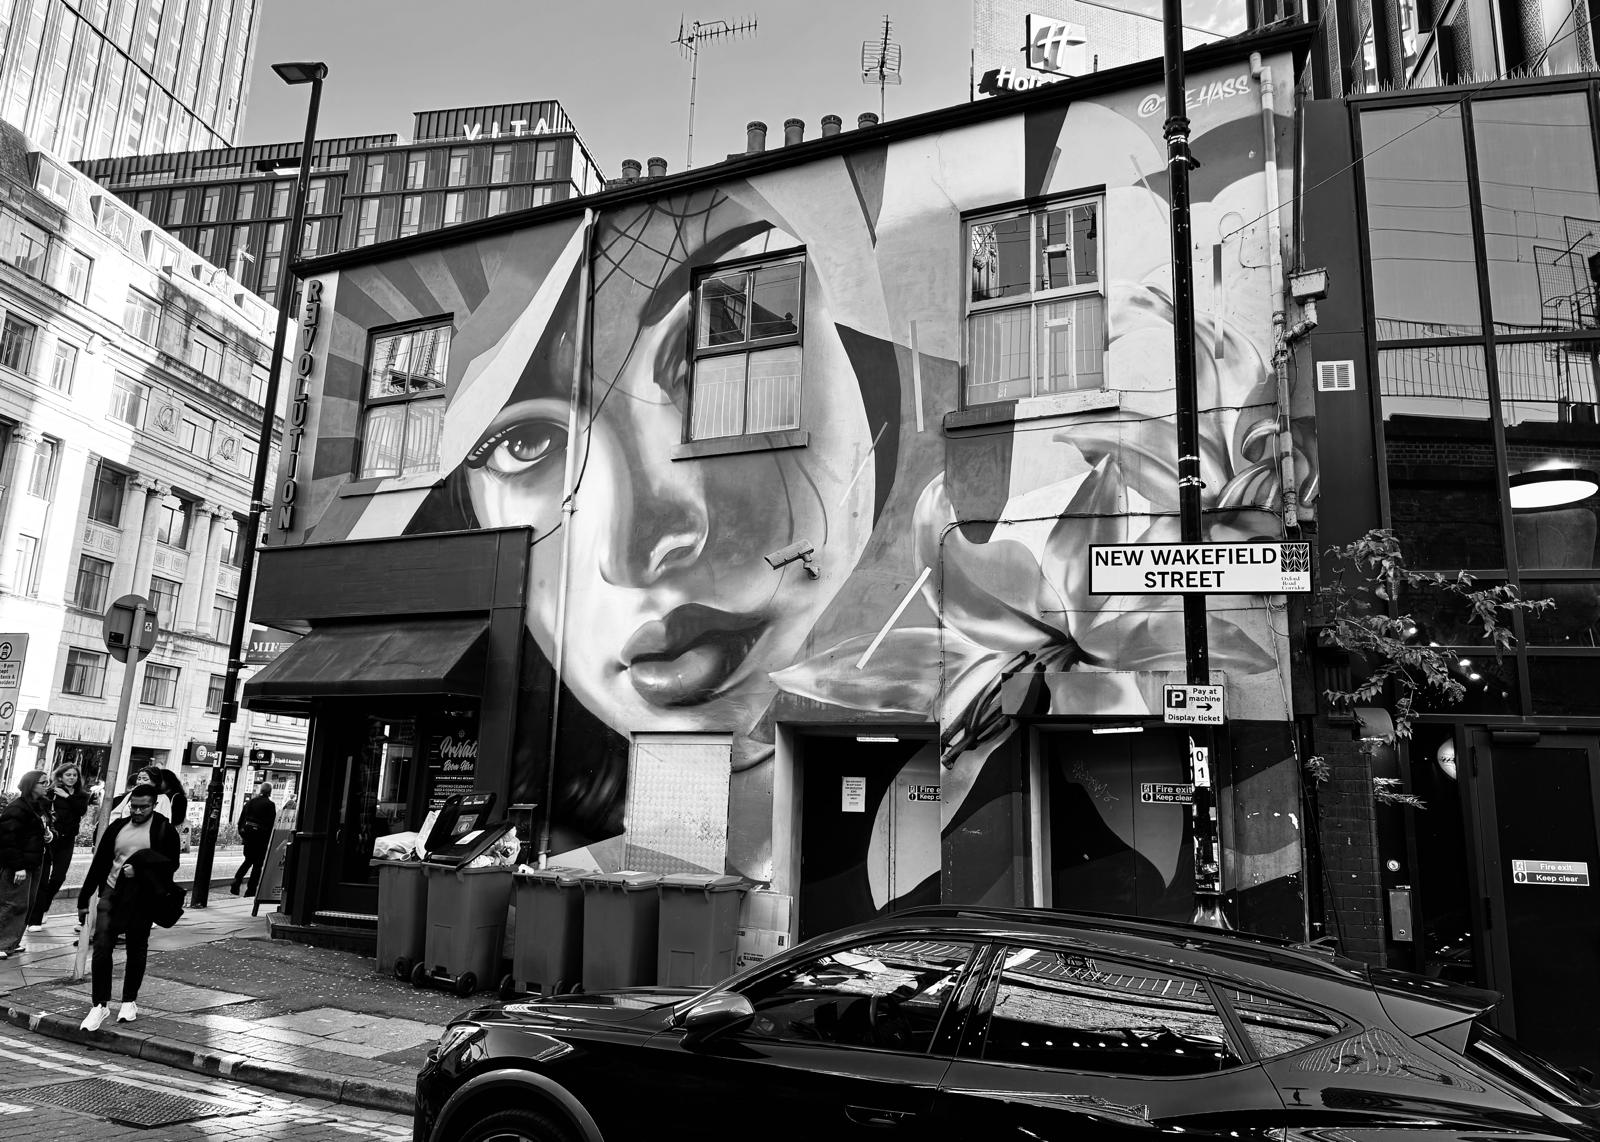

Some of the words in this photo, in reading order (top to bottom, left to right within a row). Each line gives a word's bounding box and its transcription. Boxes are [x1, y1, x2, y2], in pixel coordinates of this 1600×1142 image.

[463, 117, 549, 141] VITA
[1095, 549, 1144, 567] NEW
[1150, 547, 1278, 566] WAKEFIELD
[1144, 570, 1226, 588] STREET
[1171, 691, 1184, 707] P
[1192, 687, 1207, 696] Pay
[1168, 713, 1196, 722] Display
[1198, 714, 1221, 722] ticket
[920, 785, 935, 793] Fire
[1155, 784, 1174, 793] Fire
[1175, 785, 1192, 794] exit
[1155, 793, 1174, 802] Keep
[1175, 794, 1193, 802] clear
[1536, 874, 1557, 883] Keep
